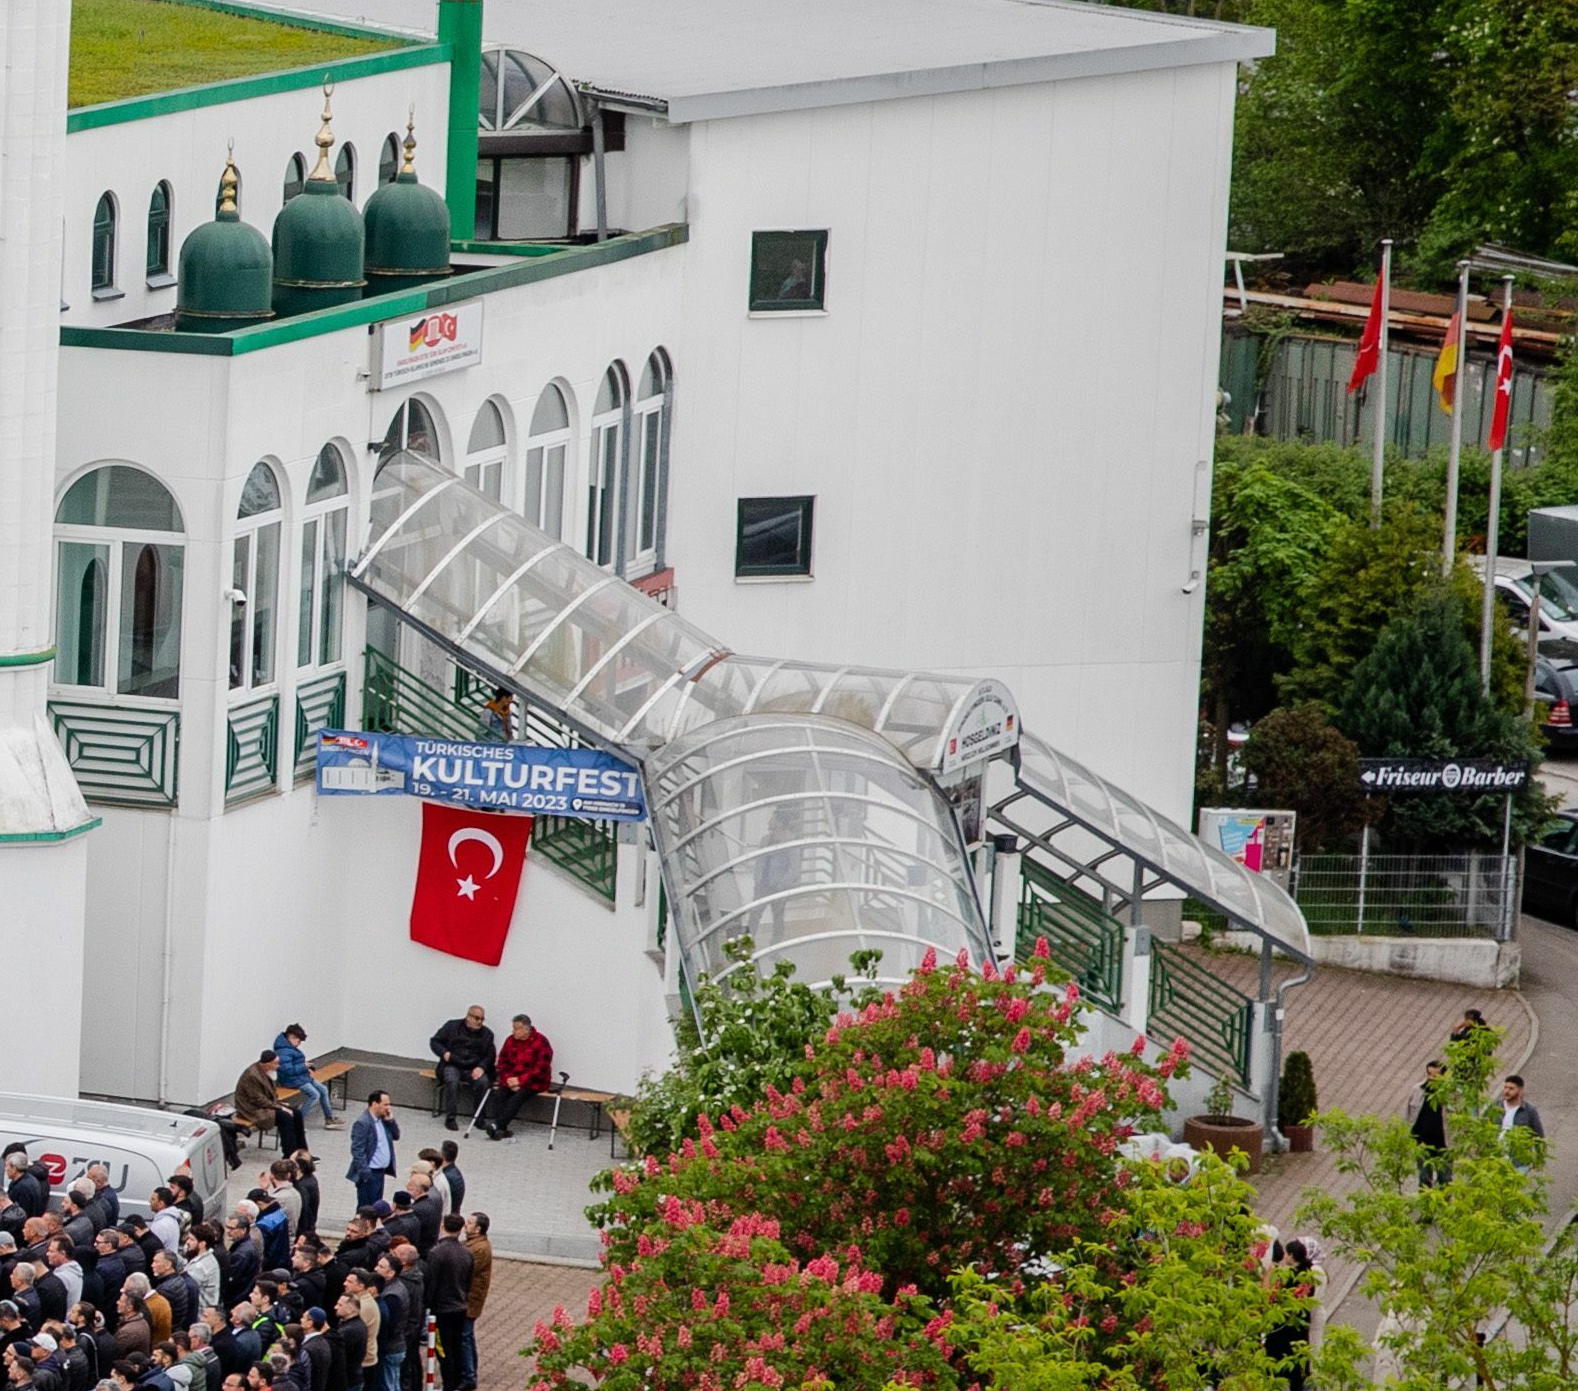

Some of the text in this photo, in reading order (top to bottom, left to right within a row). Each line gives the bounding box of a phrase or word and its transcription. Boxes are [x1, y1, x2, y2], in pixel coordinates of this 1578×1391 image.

[416, 740, 515, 760] TÜRKISCHES
[413, 756, 640, 798] KULTURFEST
[1375, 766, 1526, 786] Friseur Barber
[412, 781, 435, 796] 19.
[451, 788, 475, 802] 21.
[480, 790, 517, 807] MAI
[522, 793, 567, 811] 2023
